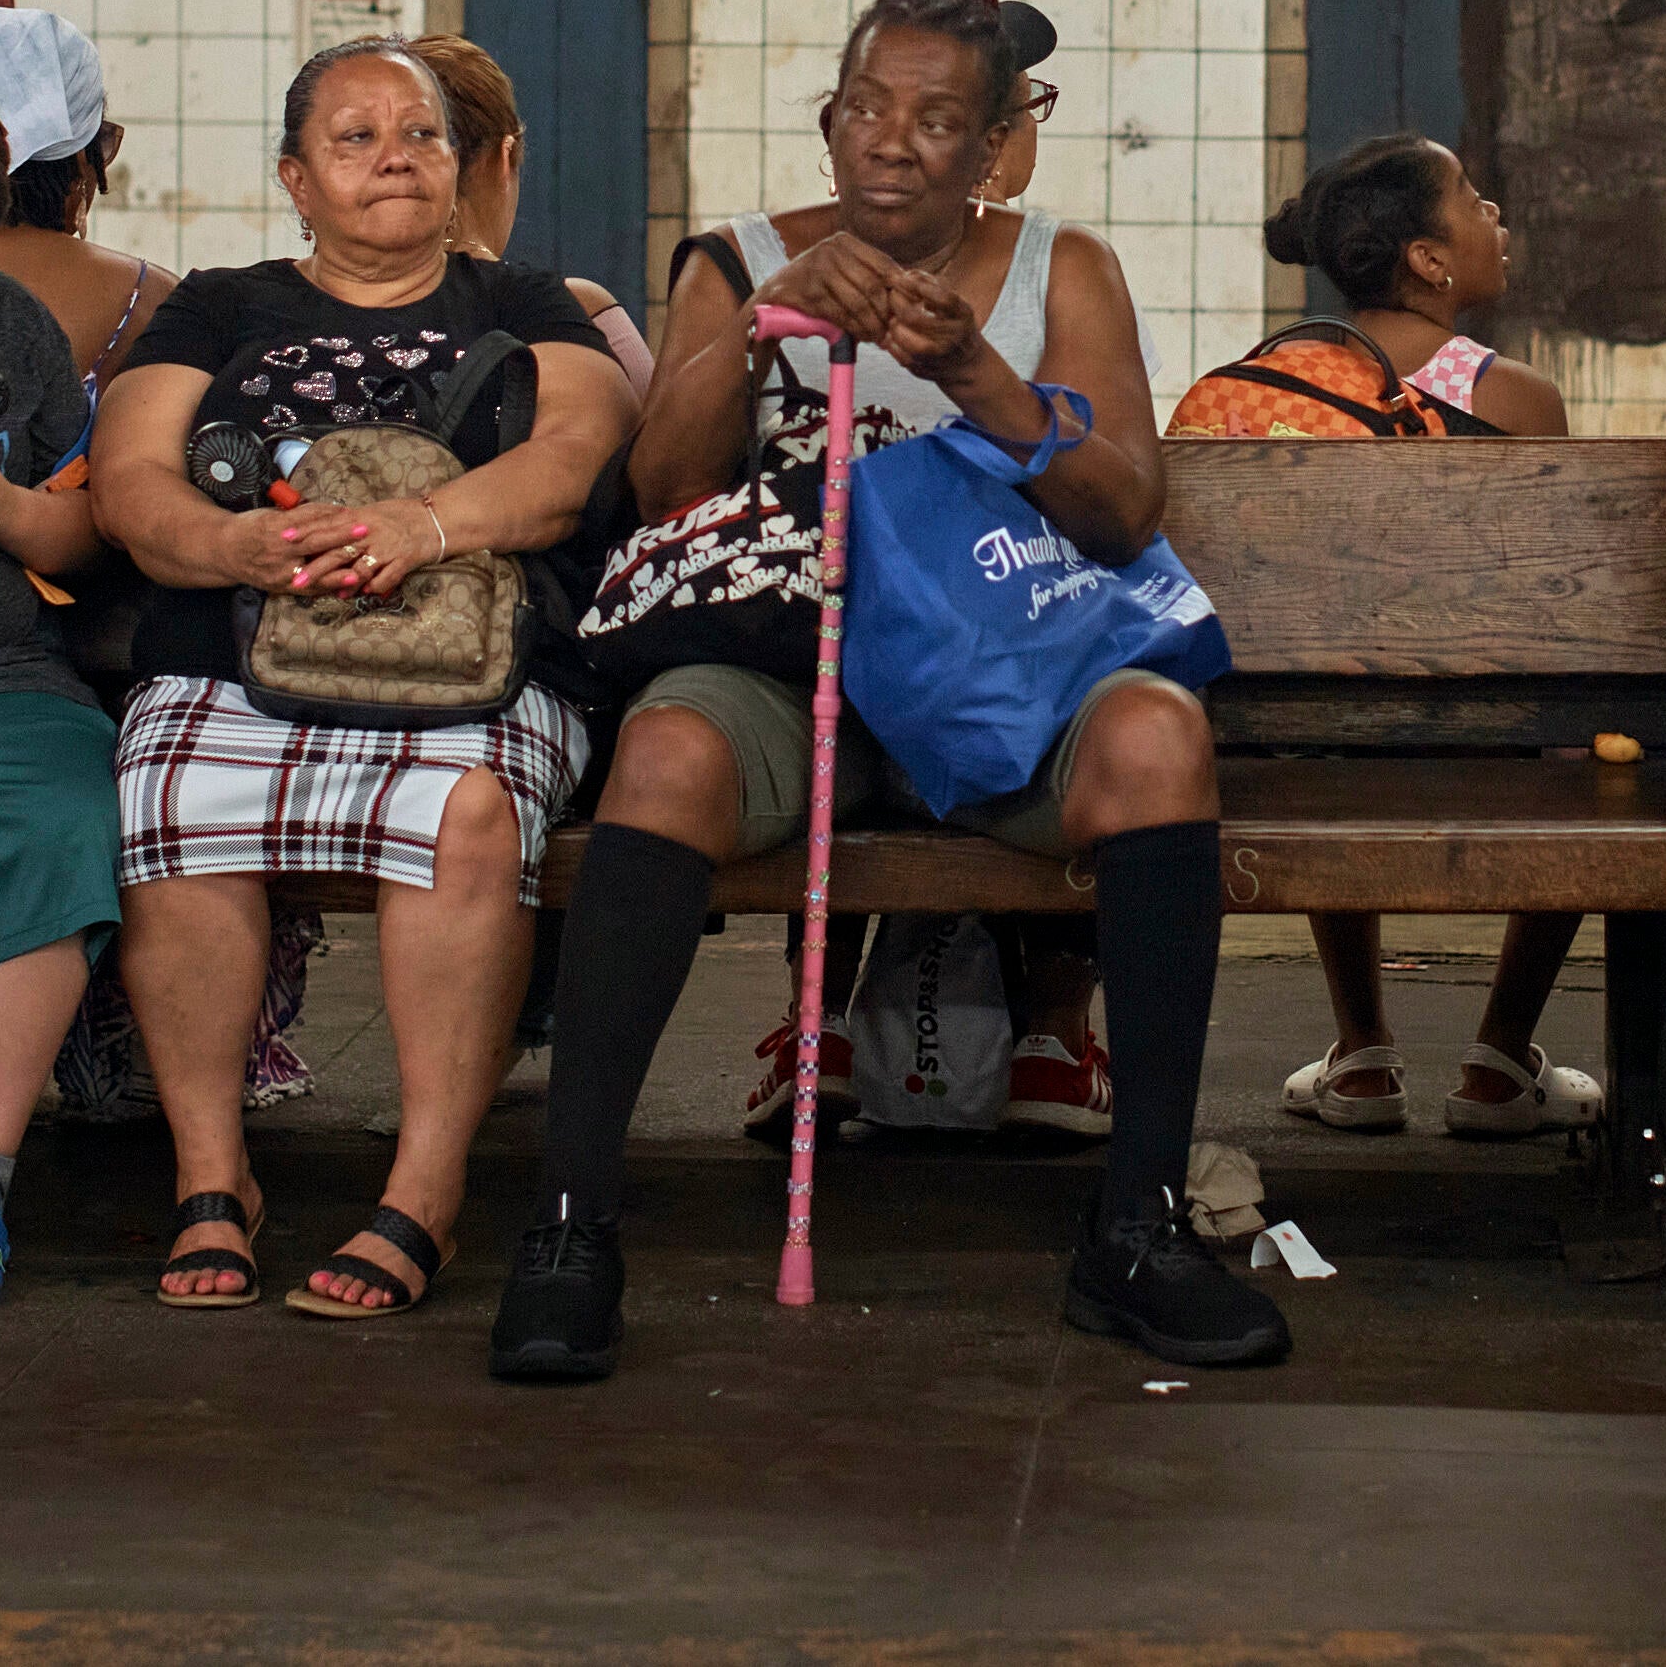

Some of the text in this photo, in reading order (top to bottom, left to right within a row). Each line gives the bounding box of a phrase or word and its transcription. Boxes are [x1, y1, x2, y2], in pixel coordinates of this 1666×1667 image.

[595, 481, 781, 600] ARUBA
[747, 530, 815, 555] ARUBA
[973, 516, 1084, 582] Thank yo
[678, 543, 743, 581] ARUBA
[628, 571, 676, 623] ARUBA
[728, 568, 783, 601] ARUBA
[786, 572, 824, 606] ARU
[1027, 582, 1053, 621] for
